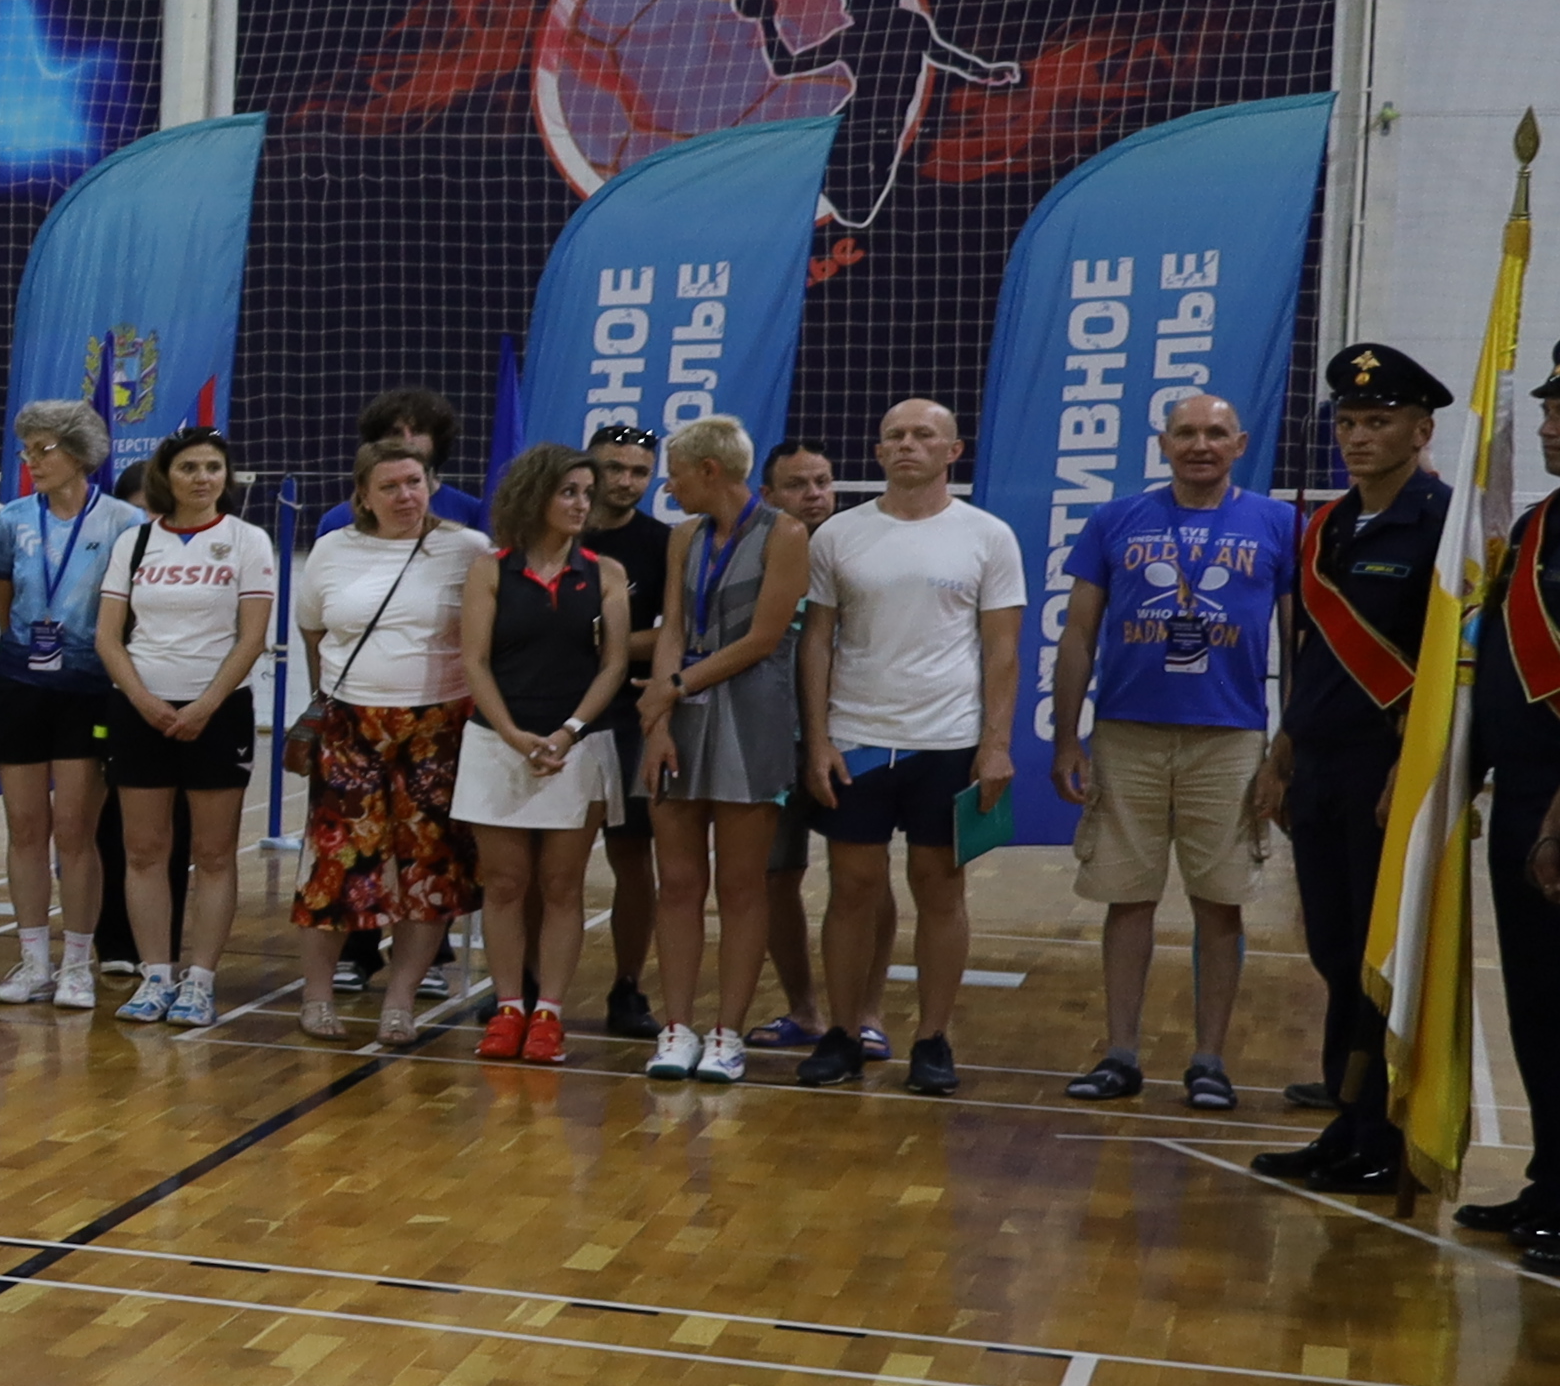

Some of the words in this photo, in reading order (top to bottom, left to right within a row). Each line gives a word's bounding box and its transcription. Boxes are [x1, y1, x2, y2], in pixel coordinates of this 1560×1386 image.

[1124, 542, 1179, 571] OLD
[1137, 608, 1173, 620] WHO
[1177, 609, 1228, 623] PAYS
